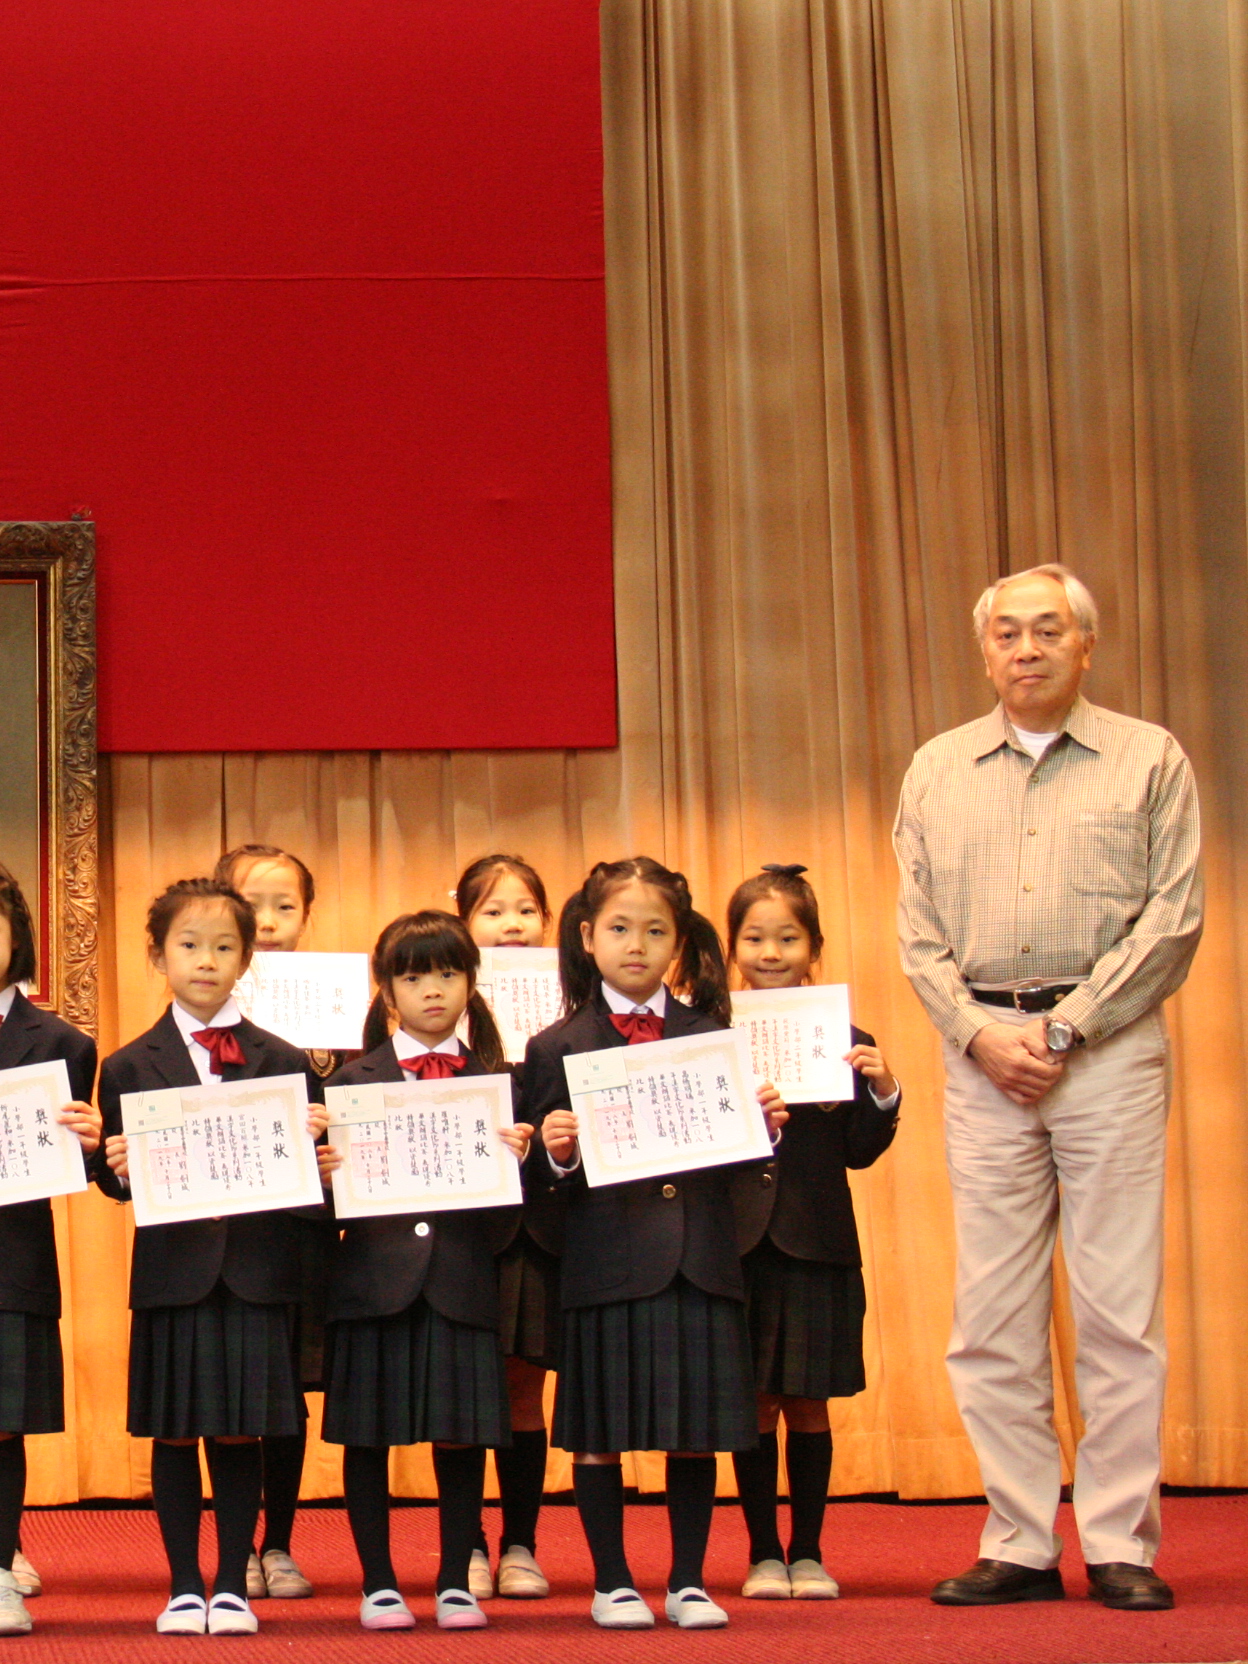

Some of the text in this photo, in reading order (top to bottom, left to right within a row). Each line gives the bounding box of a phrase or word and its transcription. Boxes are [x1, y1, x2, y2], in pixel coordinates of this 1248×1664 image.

[716, 1075, 735, 1113] 獎狀
[35, 1108, 54, 1147] 獎狀
[271, 1121, 289, 1159] 獎狀
[474, 1119, 490, 1158] 獎狀
